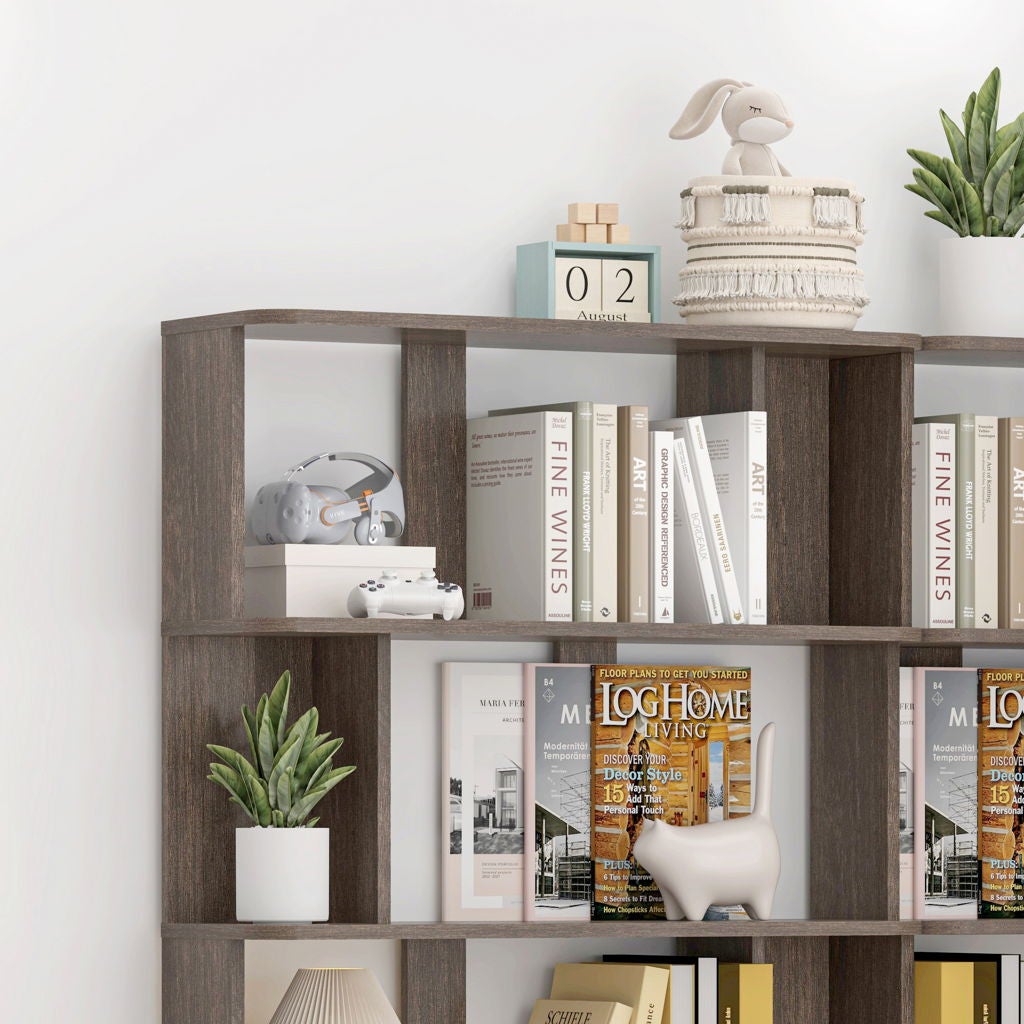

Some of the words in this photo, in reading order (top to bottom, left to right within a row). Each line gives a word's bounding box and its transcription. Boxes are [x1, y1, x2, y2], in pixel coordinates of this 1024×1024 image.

[565, 266, 589, 302] 0
[615, 268, 636, 303] 2
[577, 309, 628, 323] August
[551, 441, 568, 497] FINE
[583, 471, 591, 495] FRANK
[633, 456, 647, 492] ART
[661, 448, 669, 489] GRAPHIC
[751, 461, 765, 496] ART
[935, 452, 951, 507] FINE
[661, 491, 669, 525] DESIGN
[583, 522, 591, 552] WRIGHT
[712, 513, 727, 552] SAARINEN
[551, 509, 568, 594] WINES
[661, 527, 669, 588] REFERENCED
[721, 554, 732, 573] EERO
[935, 518, 951, 601] WINES
[599, 668, 627, 679] FLOOR
[629, 669, 657, 679] PLANS
[659, 669, 671, 679] TO
[673, 670, 689, 679] GET
[692, 670, 709, 680] YOU
[711, 670, 748, 680] STARTED
[986, 672, 1013, 682] FLOOR
[480, 699, 507, 708] MARIA
[644, 722, 707, 739] LIVING
[603, 768, 645, 781] Decor
[646, 767, 682, 785] Style
[603, 784, 624, 803] 15
[990, 785, 1010, 804] 15
[990, 806, 1024, 815] Personal
